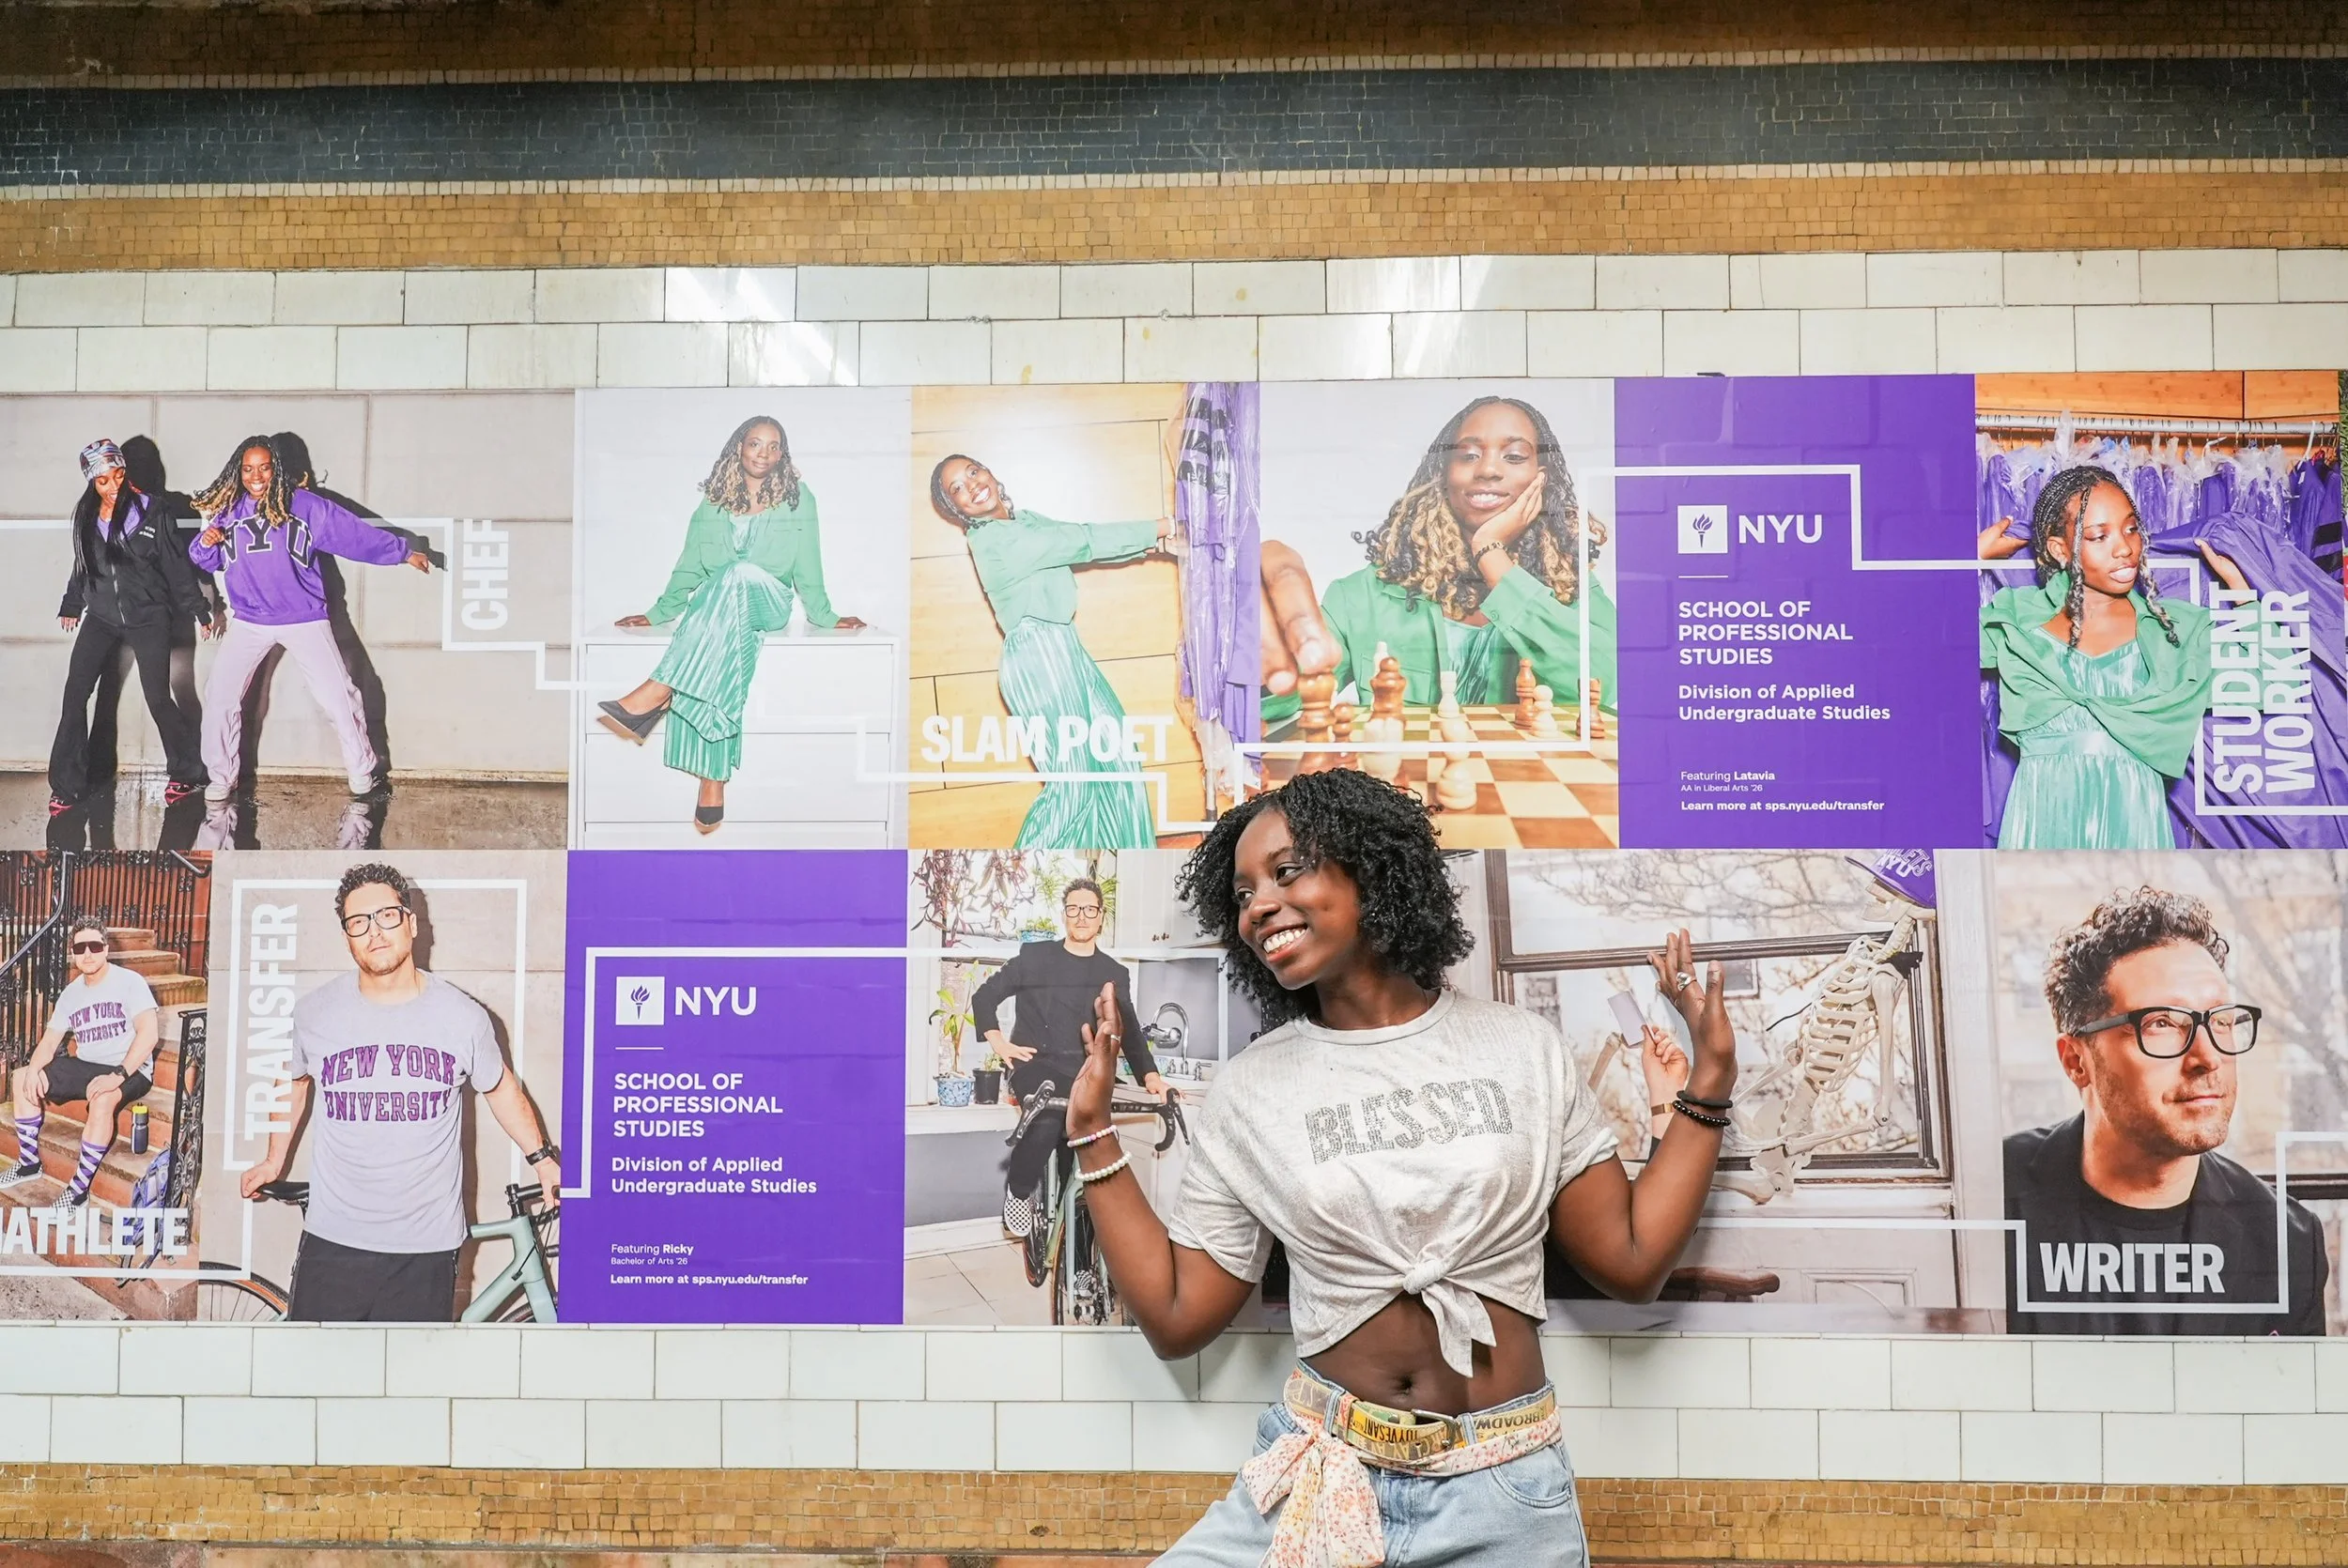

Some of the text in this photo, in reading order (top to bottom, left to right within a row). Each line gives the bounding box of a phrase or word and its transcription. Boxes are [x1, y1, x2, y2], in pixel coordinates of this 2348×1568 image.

[1738, 515, 1824, 544] NYU
[461, 518, 509, 630] CHEF
[1678, 600, 1811, 619] SCHOOL OF
[1678, 623, 1854, 641] PROFESSIONAL
[1679, 647, 1773, 665] STUDIES
[1678, 684, 1855, 701] Division of Applied
[2209, 580, 2264, 794] STUDENT
[2261, 590, 2316, 794] WORKER
[1679, 705, 1891, 723] Undergraduate Studies
[920, 714, 1175, 763] SLAM POET
[1680, 770, 1776, 783] Featuring Latavia
[1680, 784, 1693, 792] AA
[1693, 784, 1702, 792] in
[1703, 784, 1730, 792] Liberal
[1732, 784, 1749, 792] Arts
[1680, 800, 1885, 813] Learn more at sps.nyu.edu/transfer
[674, 986, 758, 1016] NYU
[69, 1002, 126, 1029] NEW YORK
[244, 903, 299, 1141] TRANSFER
[320, 1044, 456, 1087] NEW YORK
[614, 1072, 744, 1090] SCHOOL OF
[613, 1096, 783, 1114] PROFESSIONAL
[613, 1119, 704, 1137] STUDIES
[1304, 1078, 1513, 1165] BLESSED
[611, 1157, 782, 1175] Division of Applied
[611, 1177, 817, 1195] Undergraduate Studies
[0, 1207, 189, 1255] ATHLETE
[611, 1243, 694, 1256] Featuring Ricky
[610, 1256, 645, 1266] Bachelor
[647, 1256, 657, 1266] of
[657, 1256, 674, 1266] Arts
[2039, 1241, 2226, 1294] WRITER
[610, 1274, 809, 1286] Learn more at sps.nyu.edu/transfer
